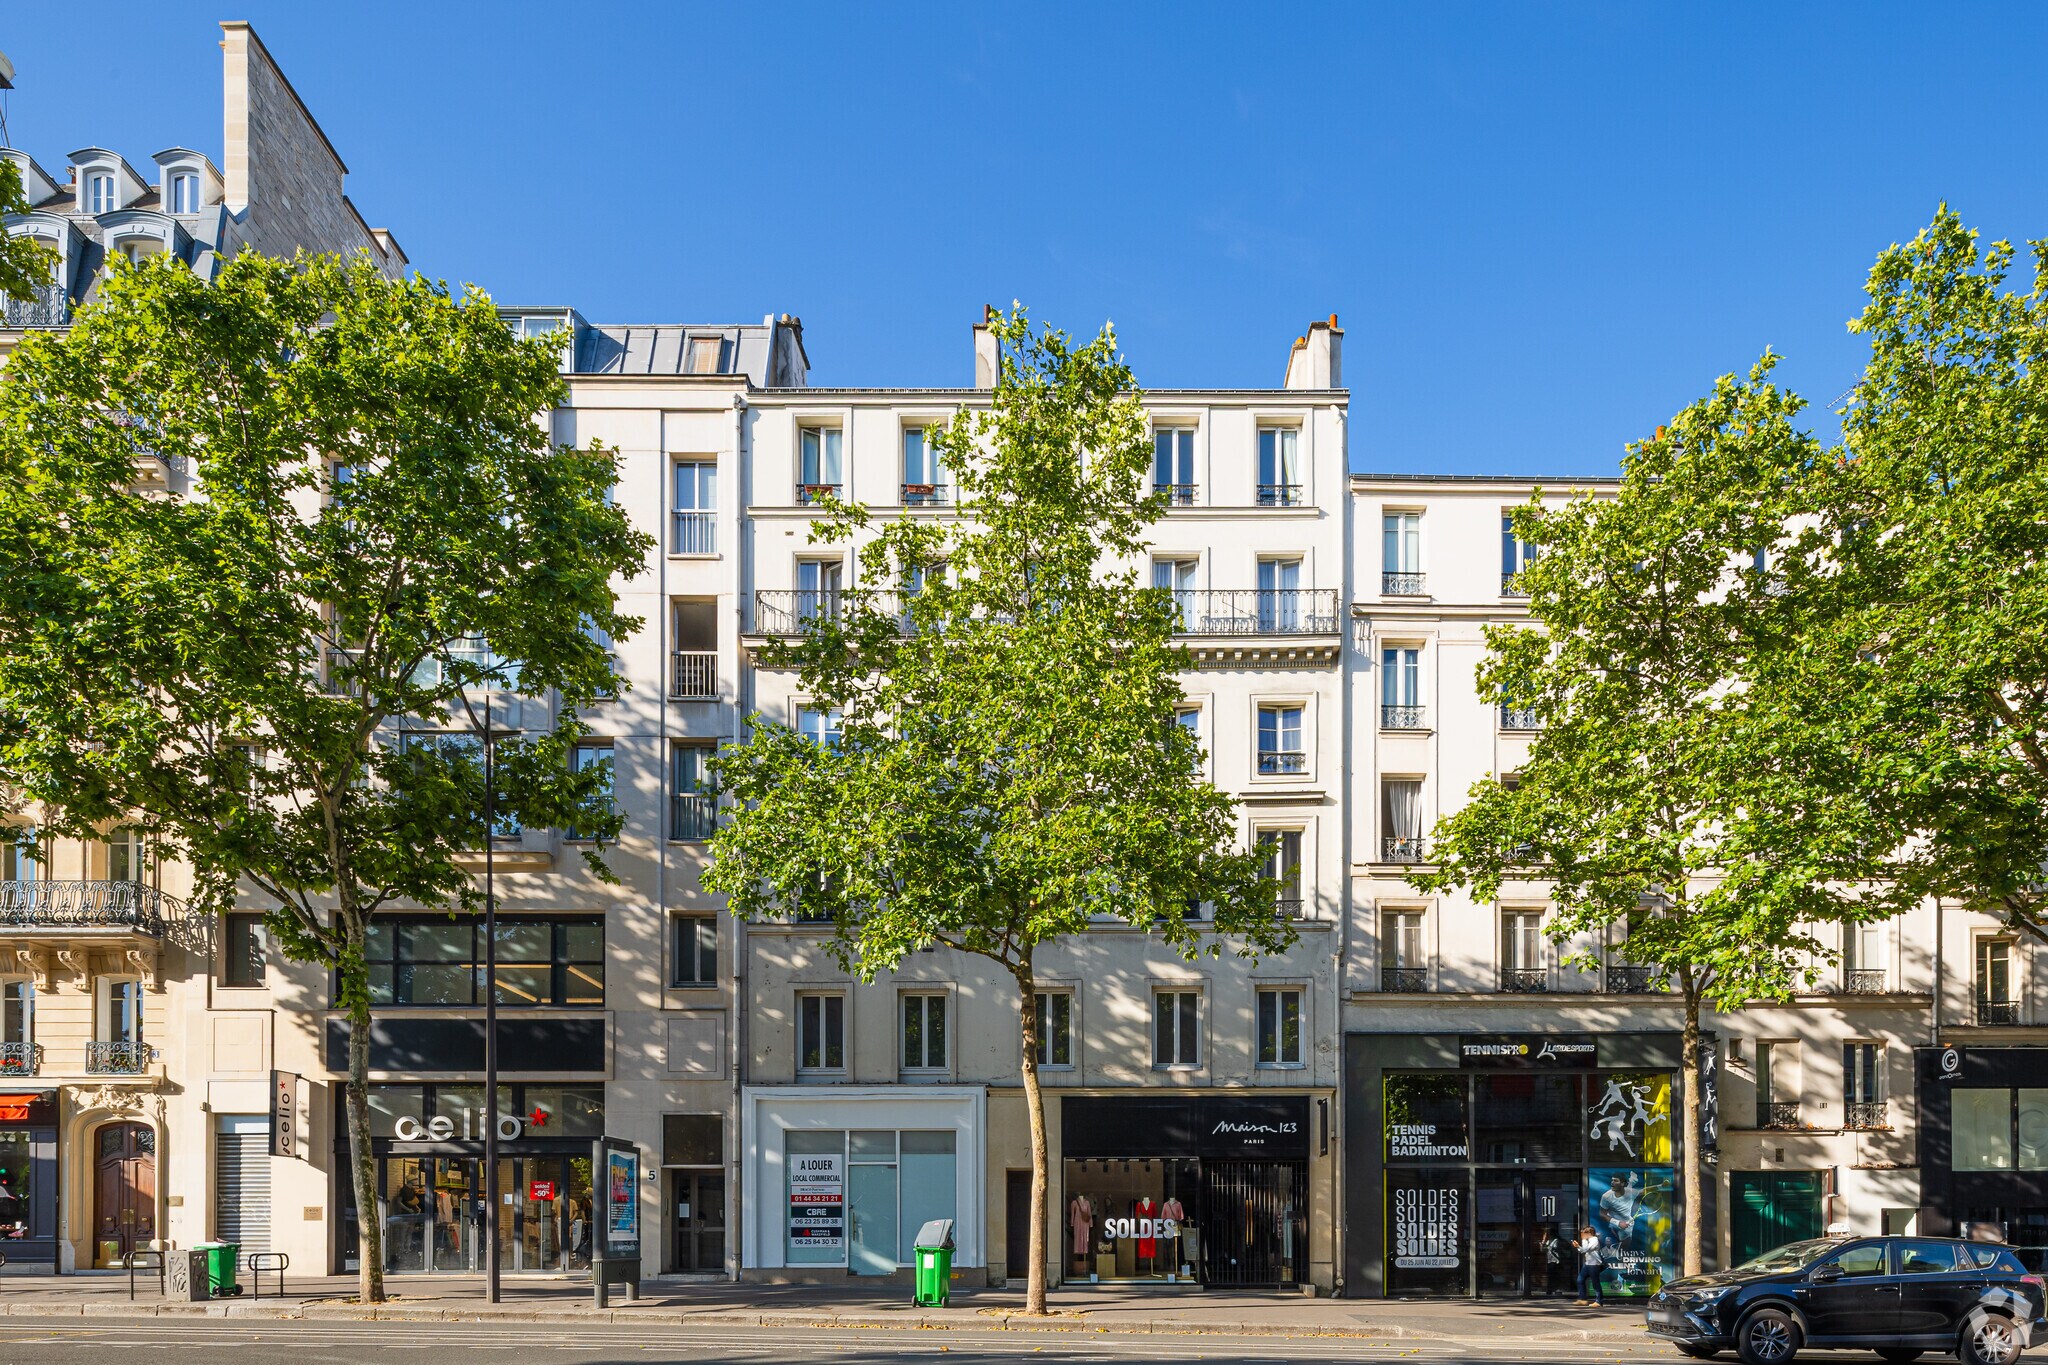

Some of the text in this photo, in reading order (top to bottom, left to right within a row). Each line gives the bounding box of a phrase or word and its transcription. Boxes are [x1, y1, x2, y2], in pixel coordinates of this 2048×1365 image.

[395, 1107, 521, 1141] celio
[1212, 1121, 1298, 1135] Maison 123
[1391, 1125, 1437, 1135] TENNIS
[1391, 1135, 1433, 1146] PADEL
[1023, 1147, 1030, 1158] 7
[1391, 1146, 1468, 1156] BADMINTON
[800, 1160, 833, 1170] A LOUER
[648, 1170, 656, 1181] 5
[1396, 1189, 1458, 1206] SOLDES
[806, 1208, 827, 1216] CBRE
[1396, 1206, 1458, 1222] SOLDES
[1104, 1218, 1176, 1239] SOLDES
[1396, 1222, 1458, 1239] SOLDES
[1396, 1239, 1458, 1256] SOLDES
[1627, 1266, 1663, 1276] forward
